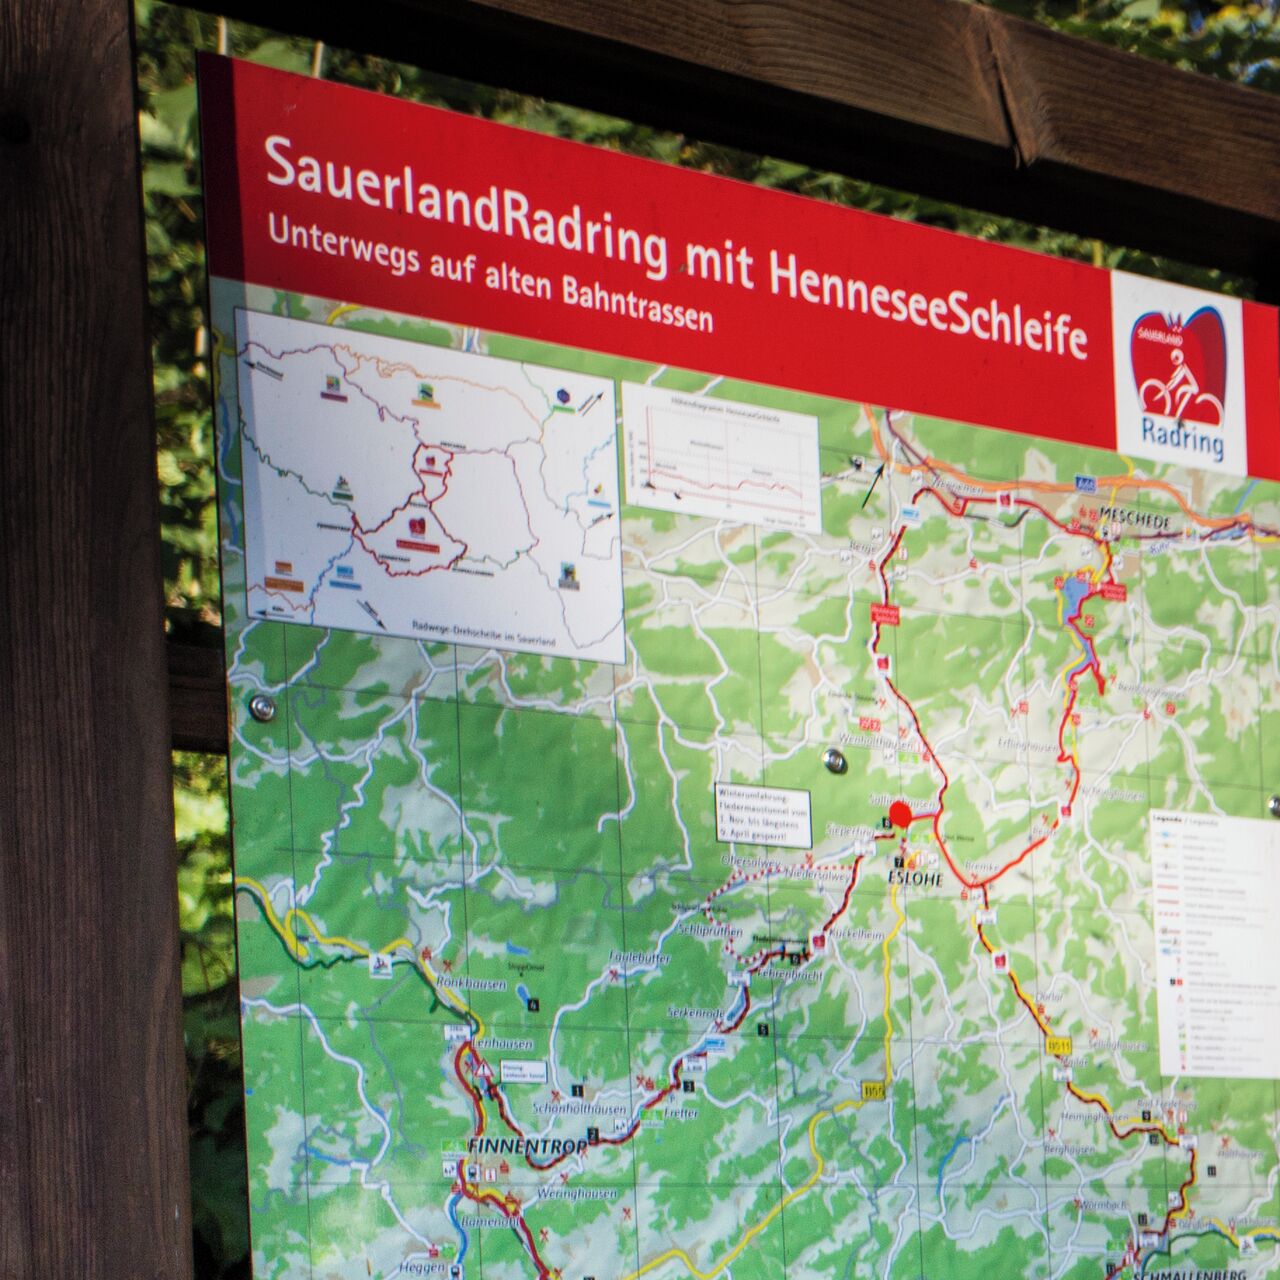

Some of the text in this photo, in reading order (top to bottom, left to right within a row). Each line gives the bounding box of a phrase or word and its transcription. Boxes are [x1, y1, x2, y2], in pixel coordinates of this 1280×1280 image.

[265, 135, 1088, 360] SauerlandRadring mit HenneseeSchleife
[269, 211, 714, 333] Unterwegs auf alten Bahntrassen
[1138, 327, 1184, 347] SAUERLAND
[1142, 417, 1224, 463] Radring
[1100, 507, 1171, 530] MESCHEDE
[888, 871, 944, 887] ESLOHE
[471, 1037, 534, 1051] Lenhausen
[468, 1138, 588, 1155] FINNENTROP
[399, 1261, 445, 1275] Heggen
